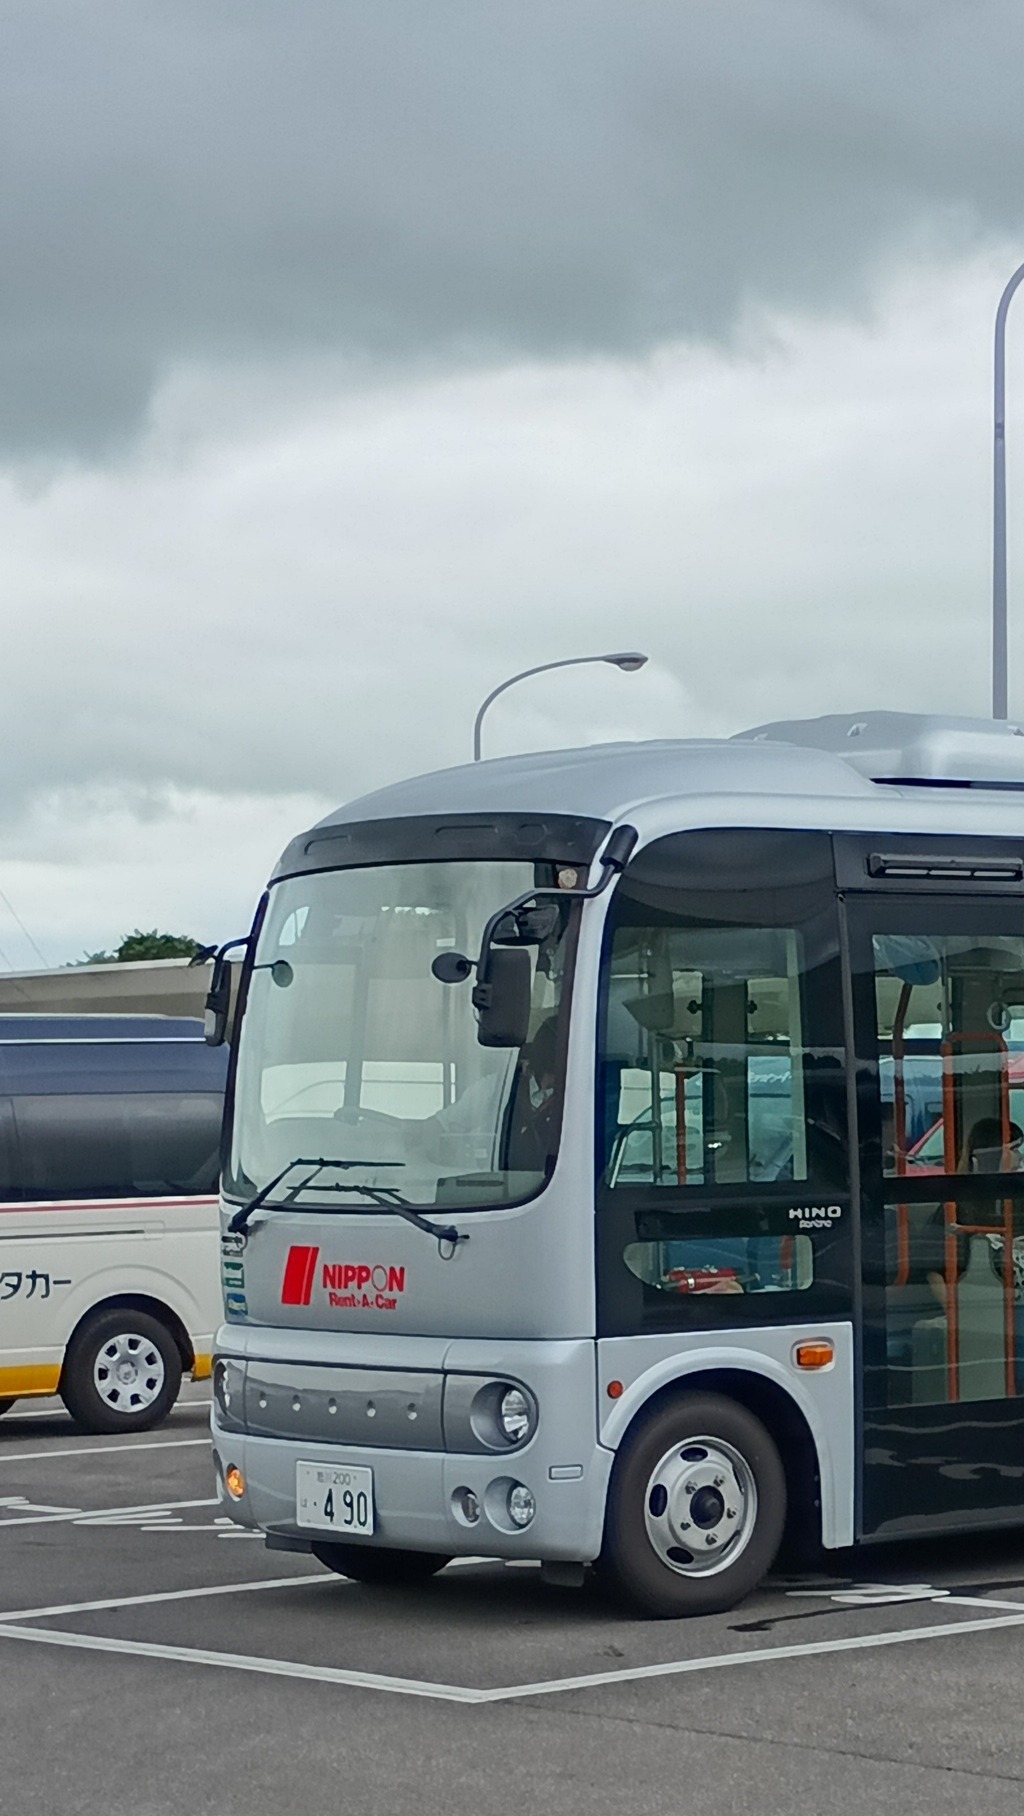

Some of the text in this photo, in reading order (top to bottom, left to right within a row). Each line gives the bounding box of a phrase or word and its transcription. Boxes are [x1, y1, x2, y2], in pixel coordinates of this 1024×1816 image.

[788, 1205, 842, 1219] HINO
[0, 1269, 72, 1300] タカー
[322, 1264, 405, 1292] NIPPON
